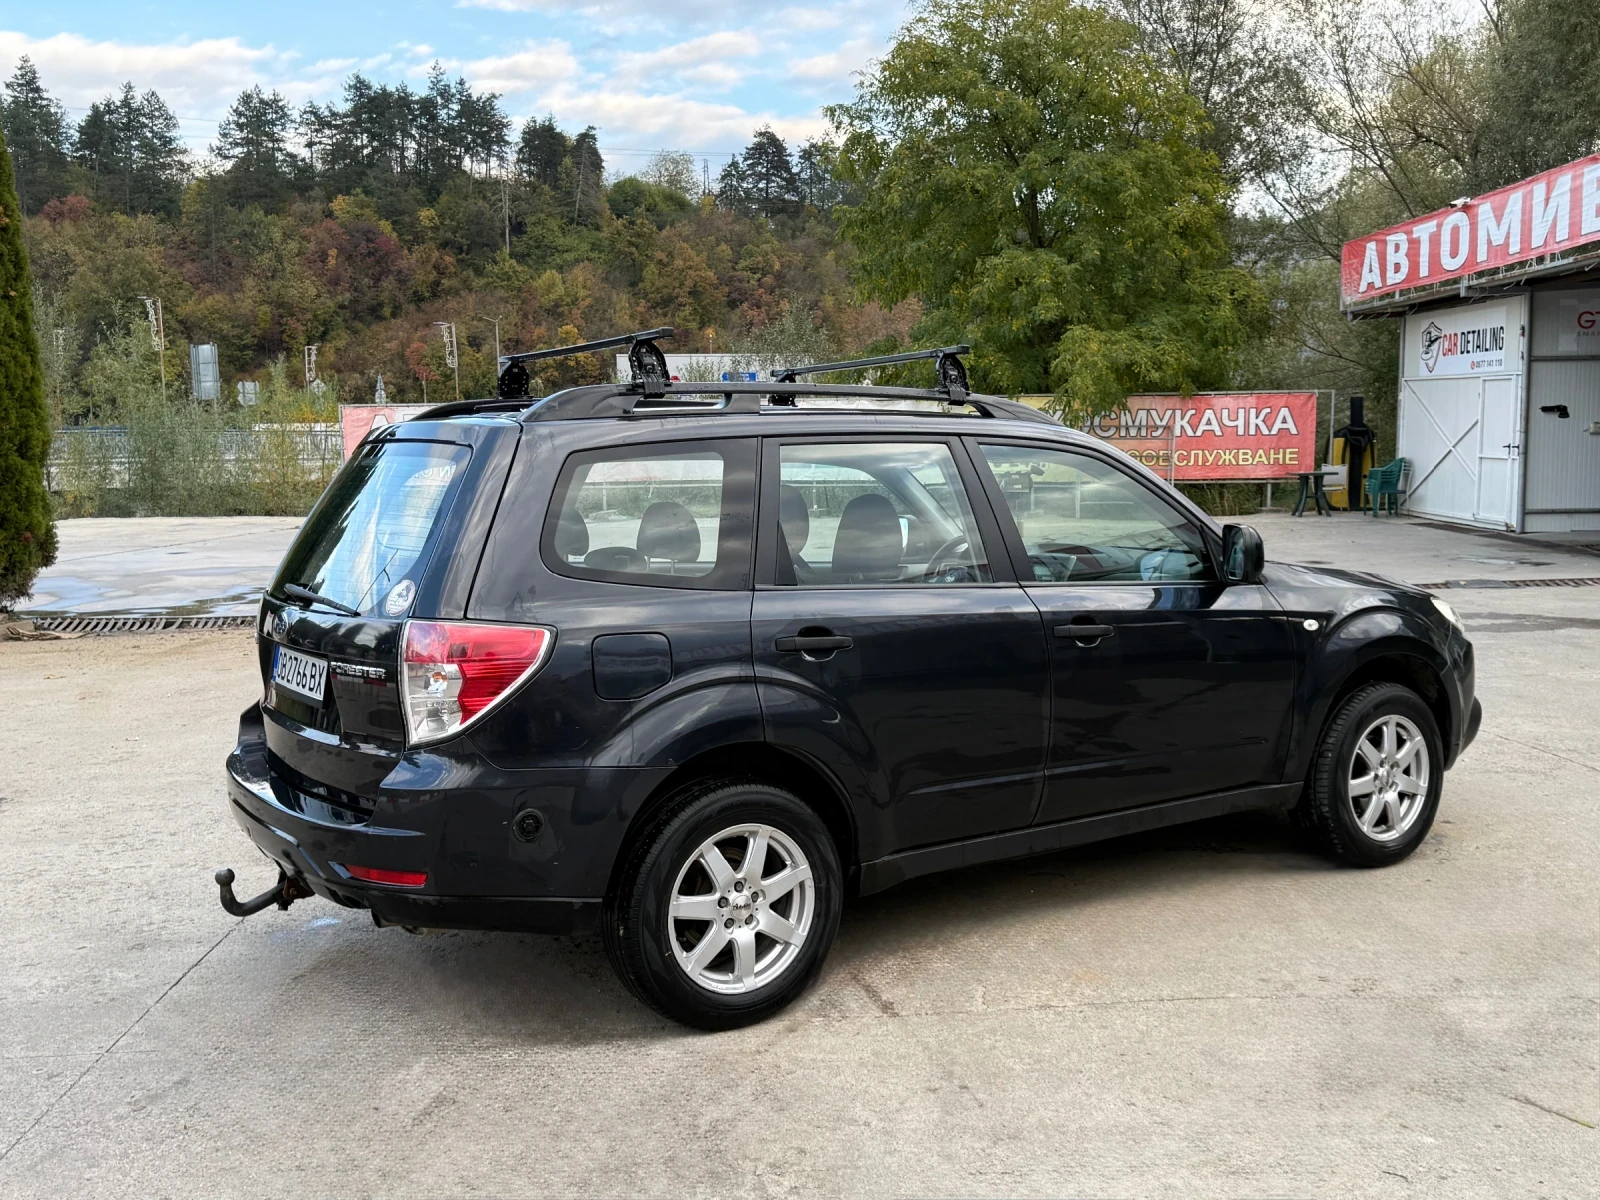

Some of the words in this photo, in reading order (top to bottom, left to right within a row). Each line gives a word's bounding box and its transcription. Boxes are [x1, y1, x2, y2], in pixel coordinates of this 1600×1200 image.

[1442, 332, 1458, 357] CAR
[1460, 326, 1504, 354] DETAILING
[330, 661, 387, 680] FORESTER
